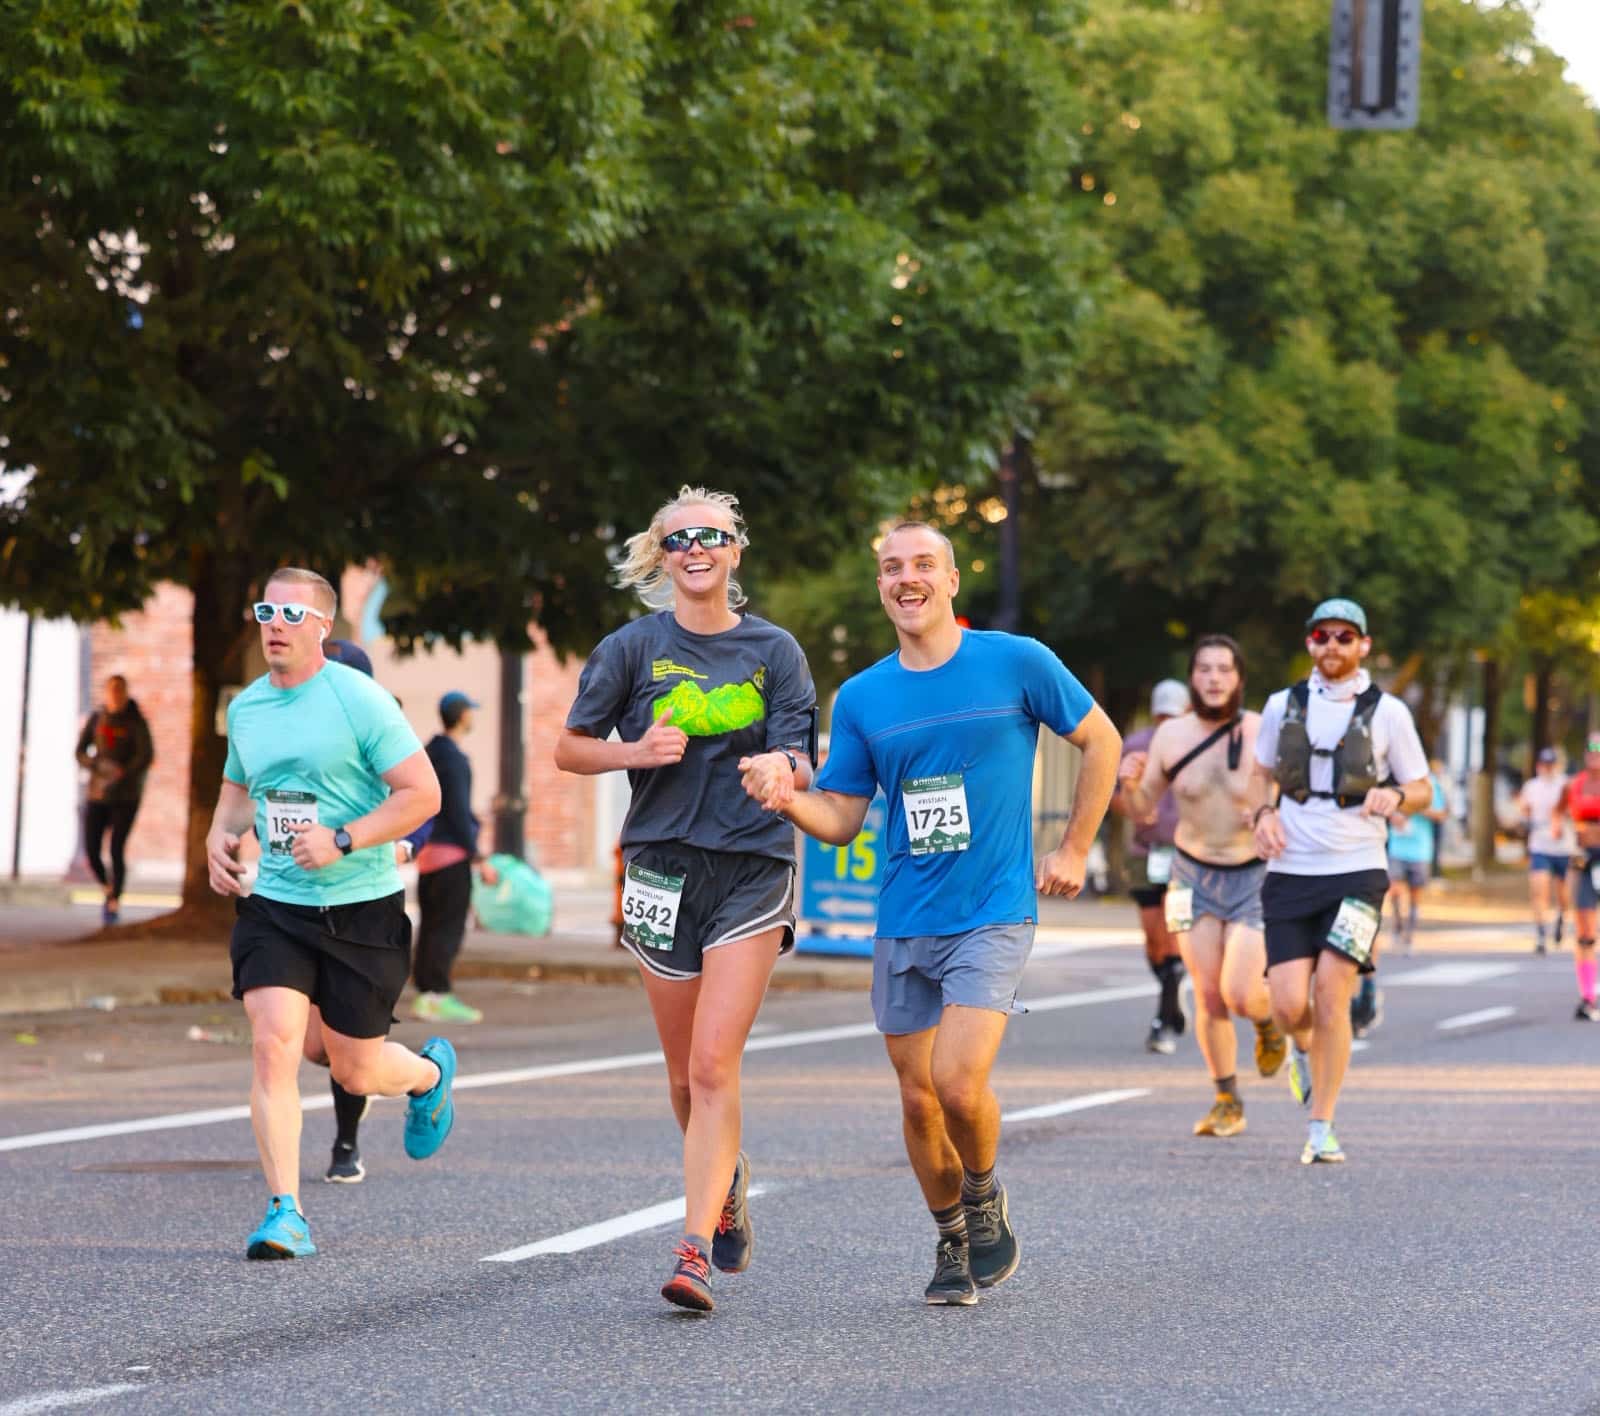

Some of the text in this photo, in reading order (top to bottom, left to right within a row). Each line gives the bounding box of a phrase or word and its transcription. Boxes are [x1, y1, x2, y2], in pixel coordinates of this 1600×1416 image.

[918, 796, 948, 805] KRISTIAN
[910, 805, 963, 830] 1725
[624, 896, 671, 927] 5542
